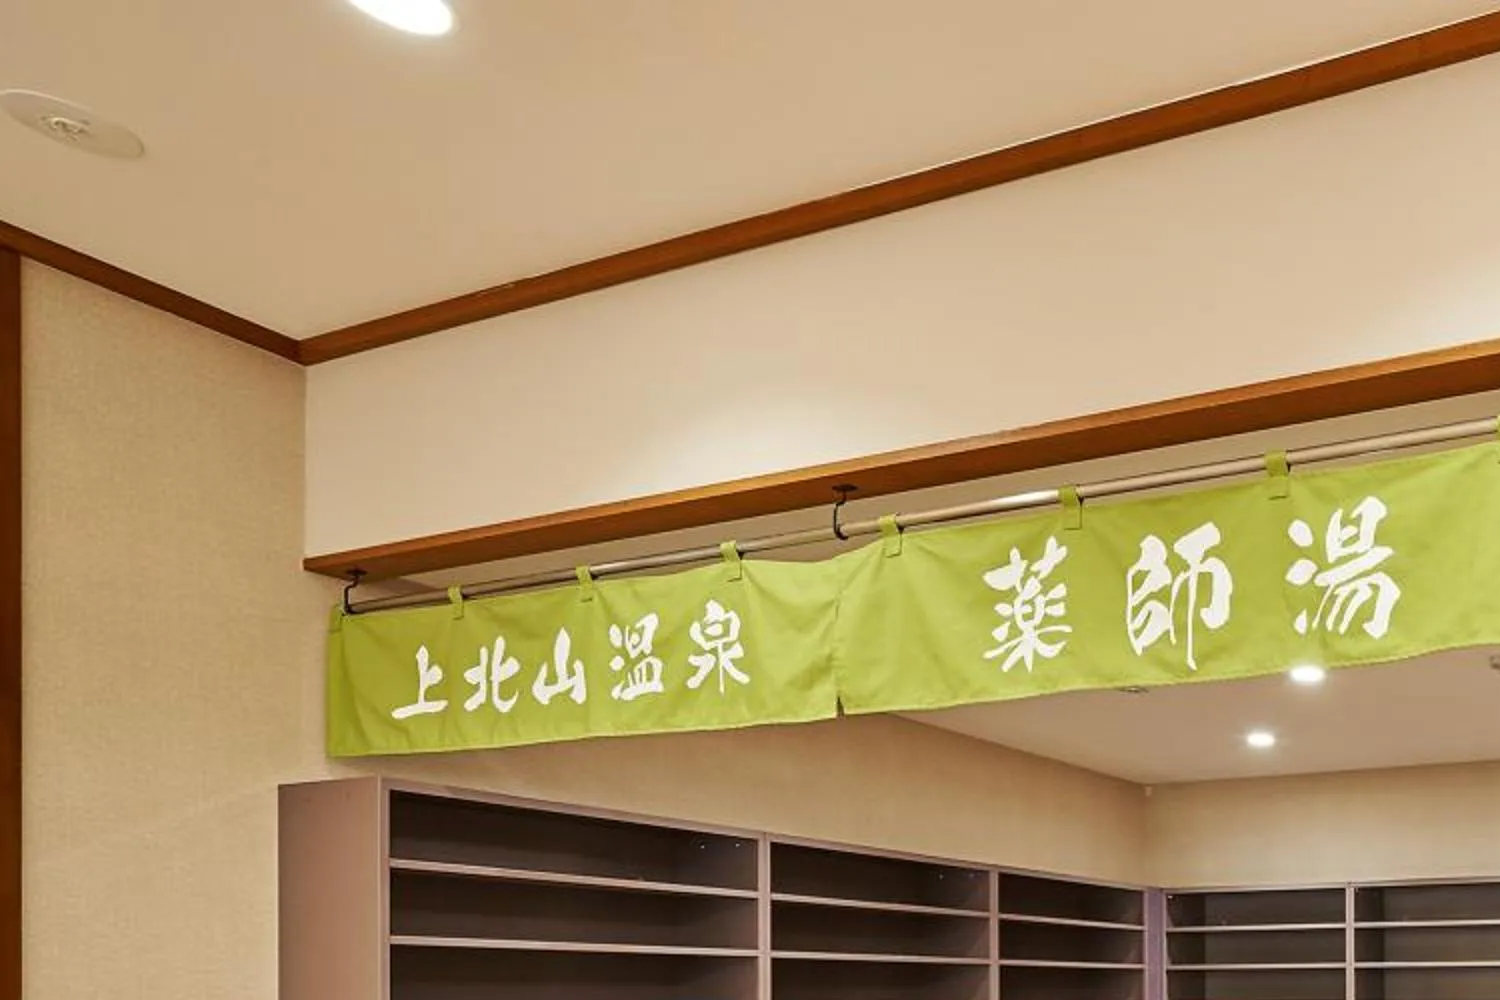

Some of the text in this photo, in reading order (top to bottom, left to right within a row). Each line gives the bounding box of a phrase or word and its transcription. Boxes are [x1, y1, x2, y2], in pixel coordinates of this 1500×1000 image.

[982, 495, 1401, 671] 薬師湯
[391, 598, 750, 720] 上北山温泉
